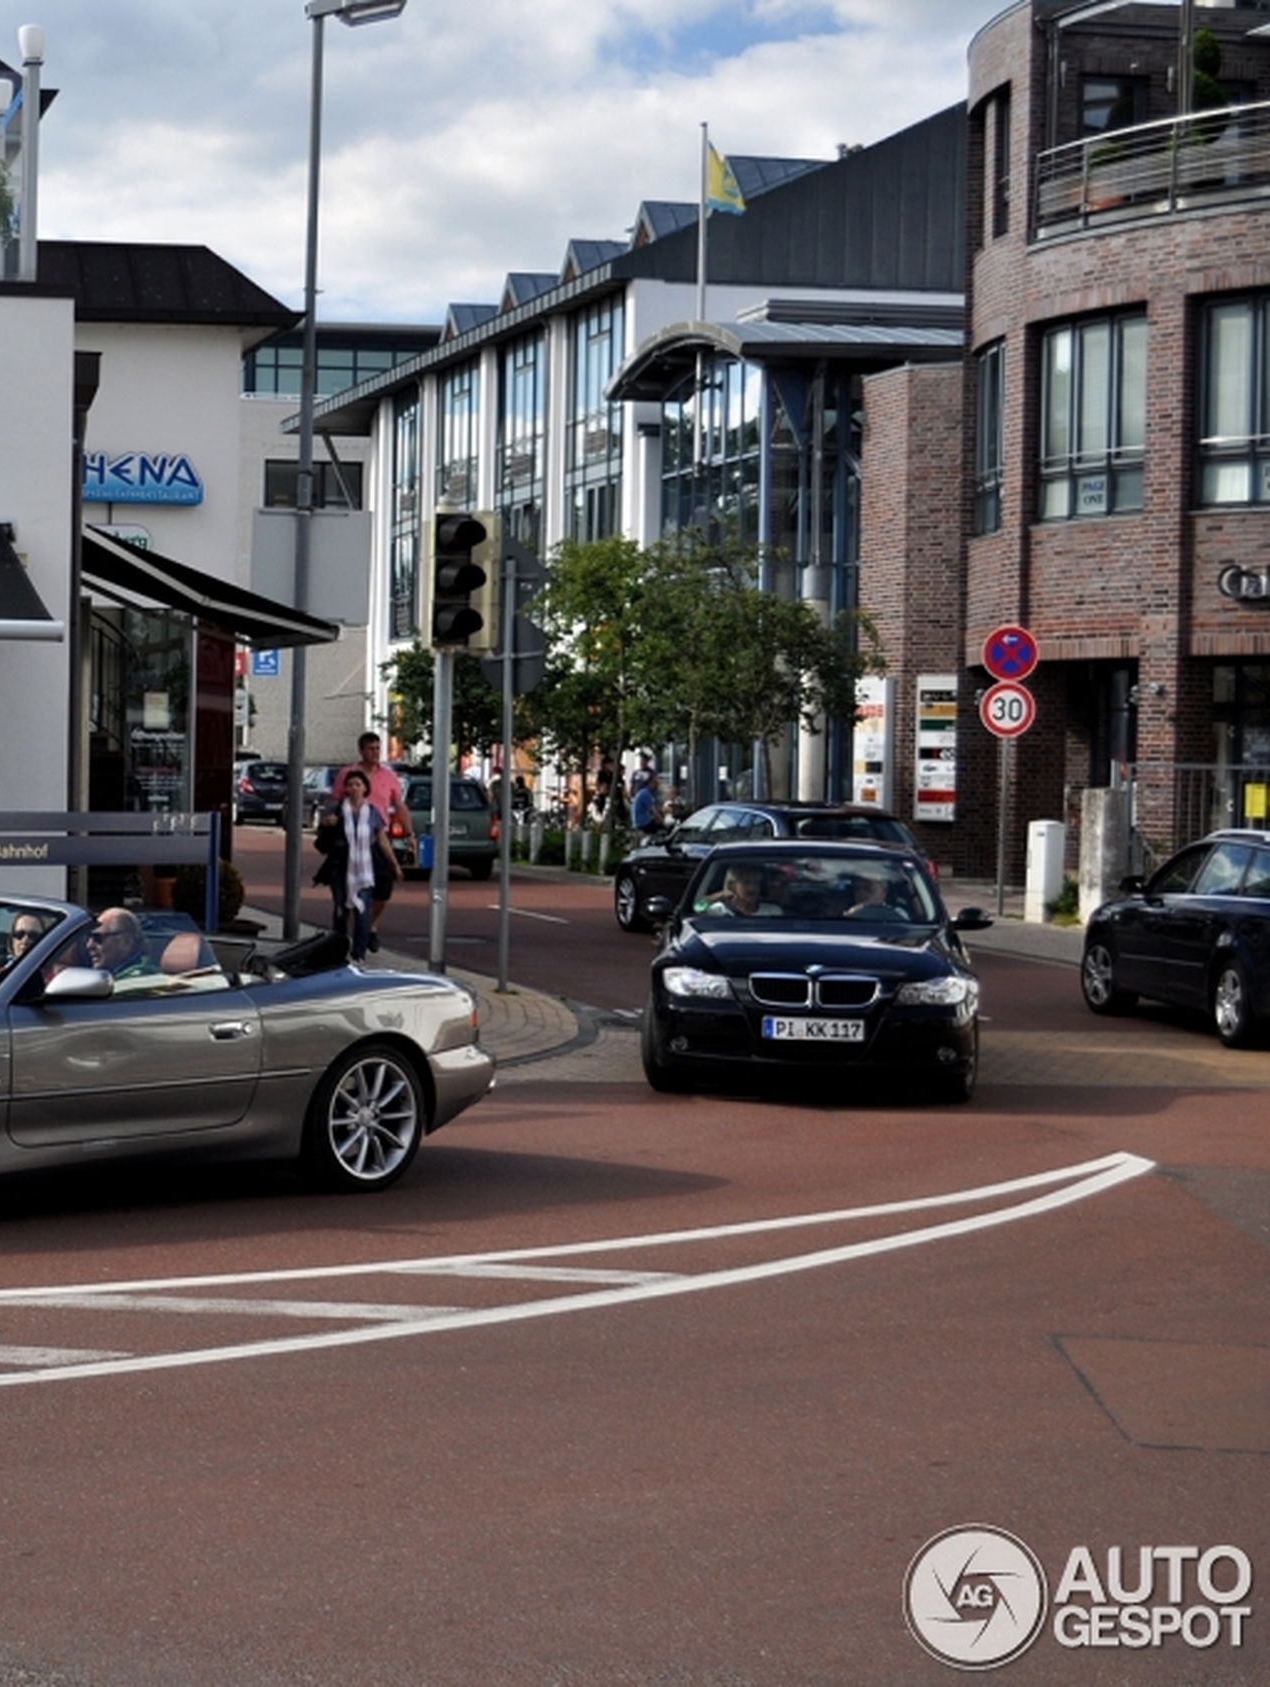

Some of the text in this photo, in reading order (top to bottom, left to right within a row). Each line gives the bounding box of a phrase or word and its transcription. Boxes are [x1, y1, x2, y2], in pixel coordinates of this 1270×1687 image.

[993, 696, 1023, 722] 30
[806, 1022, 827, 1038] KK
[830, 1023, 861, 1039] 117
